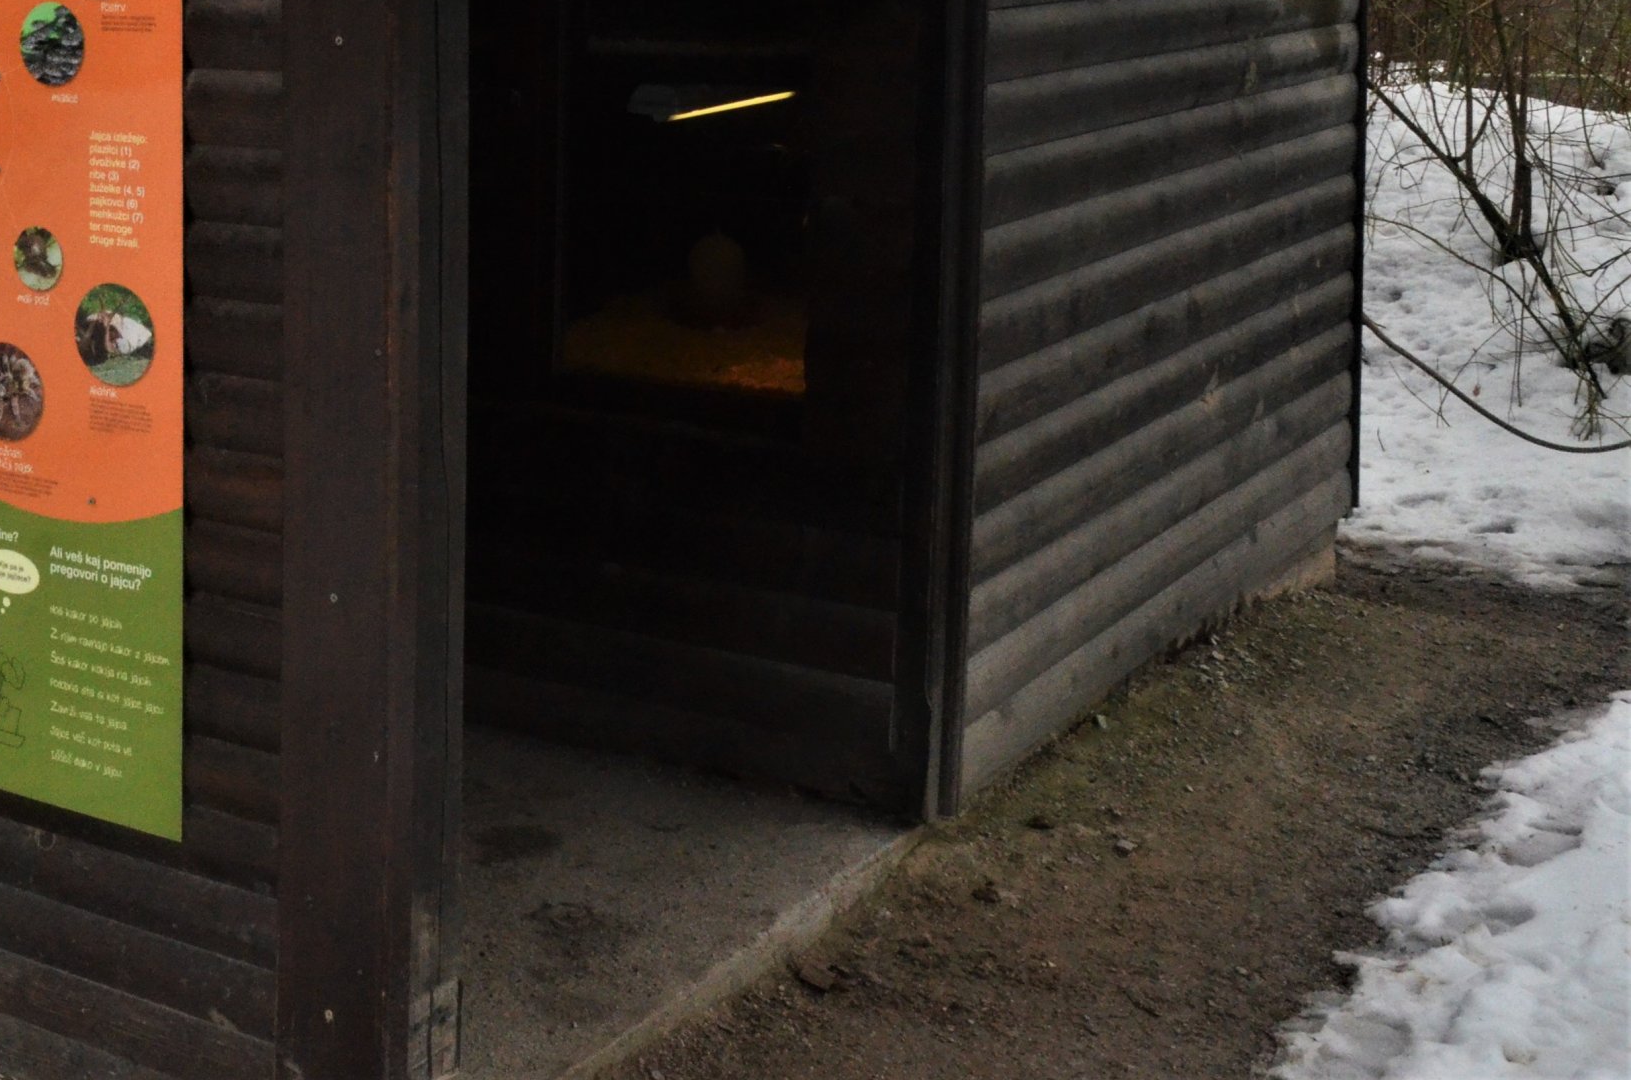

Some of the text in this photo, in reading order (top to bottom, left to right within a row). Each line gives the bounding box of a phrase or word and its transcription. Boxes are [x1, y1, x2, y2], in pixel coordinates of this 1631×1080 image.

[127, 159, 140, 171] (2)
[131, 211, 144, 224] (7)
[102, 224, 133, 236] mnoge
[89, 234, 115, 248] druge
[50, 545, 152, 580] Ali veš kaj pomenijo
[50, 563, 142, 591] pregovori o jajcu?
[50, 626, 59, 639] Z
